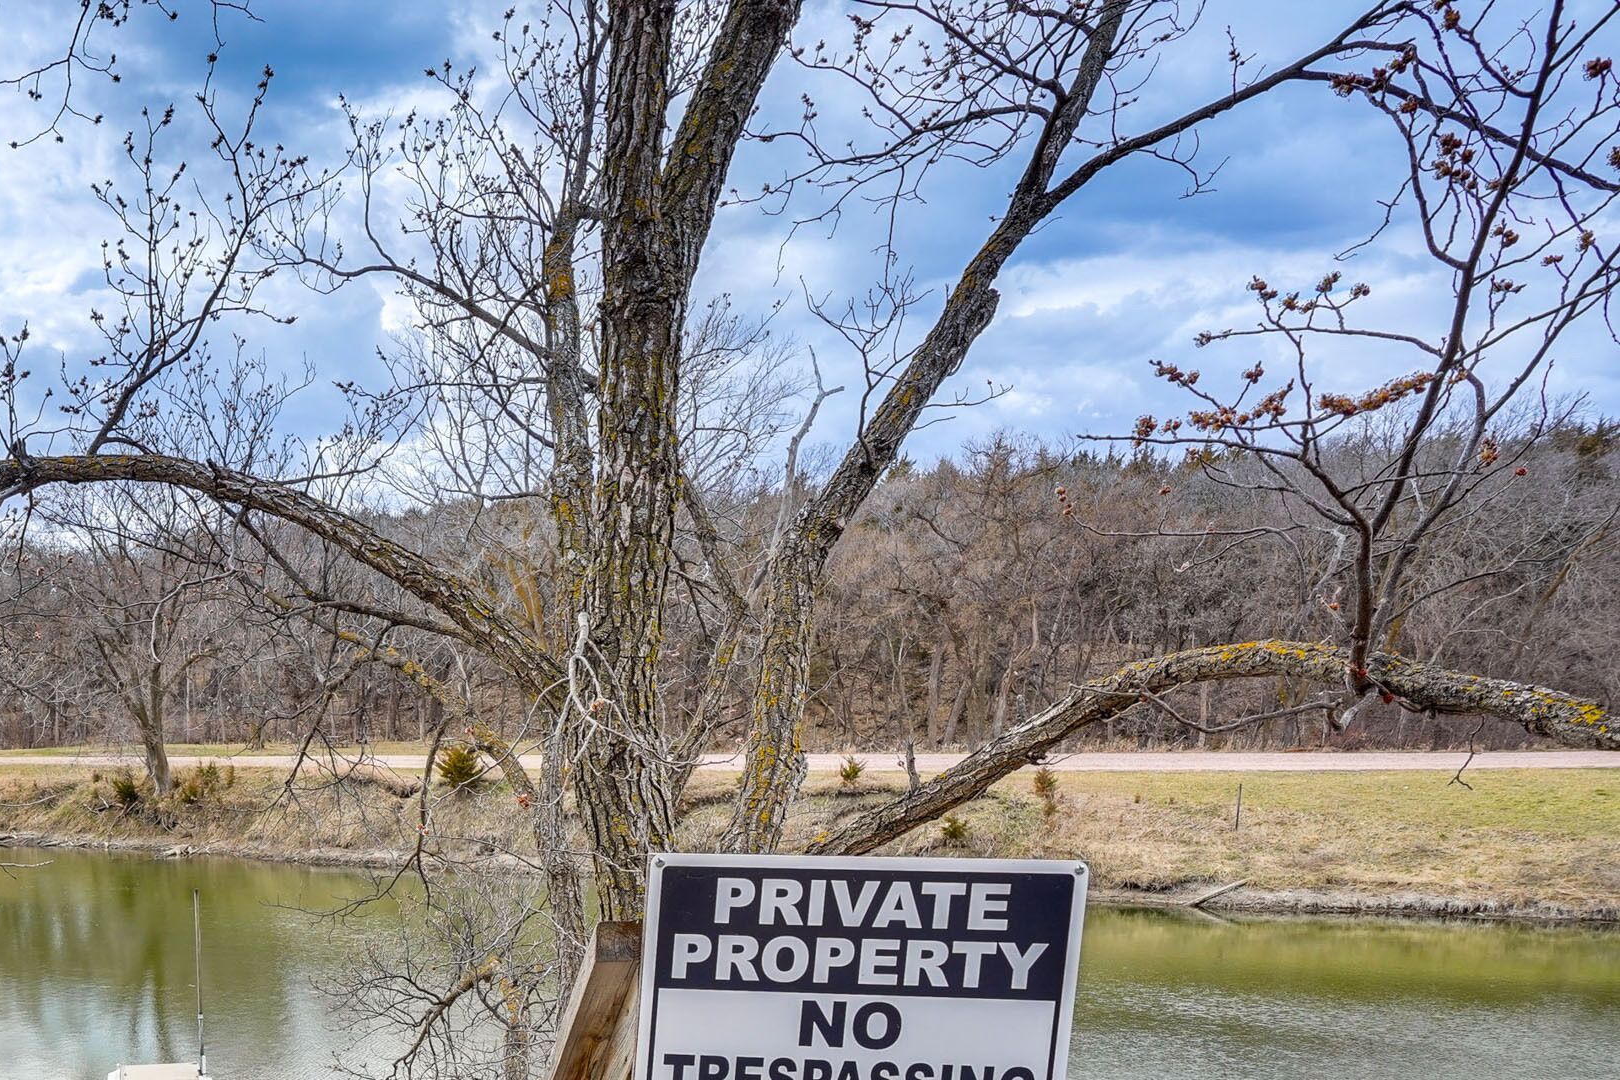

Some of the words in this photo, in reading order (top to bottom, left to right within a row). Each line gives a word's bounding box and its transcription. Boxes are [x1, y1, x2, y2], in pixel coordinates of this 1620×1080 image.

[713, 877, 1012, 931] PRIVATE
[670, 933, 1050, 990] PROPERTY
[798, 1000, 902, 1051] NO
